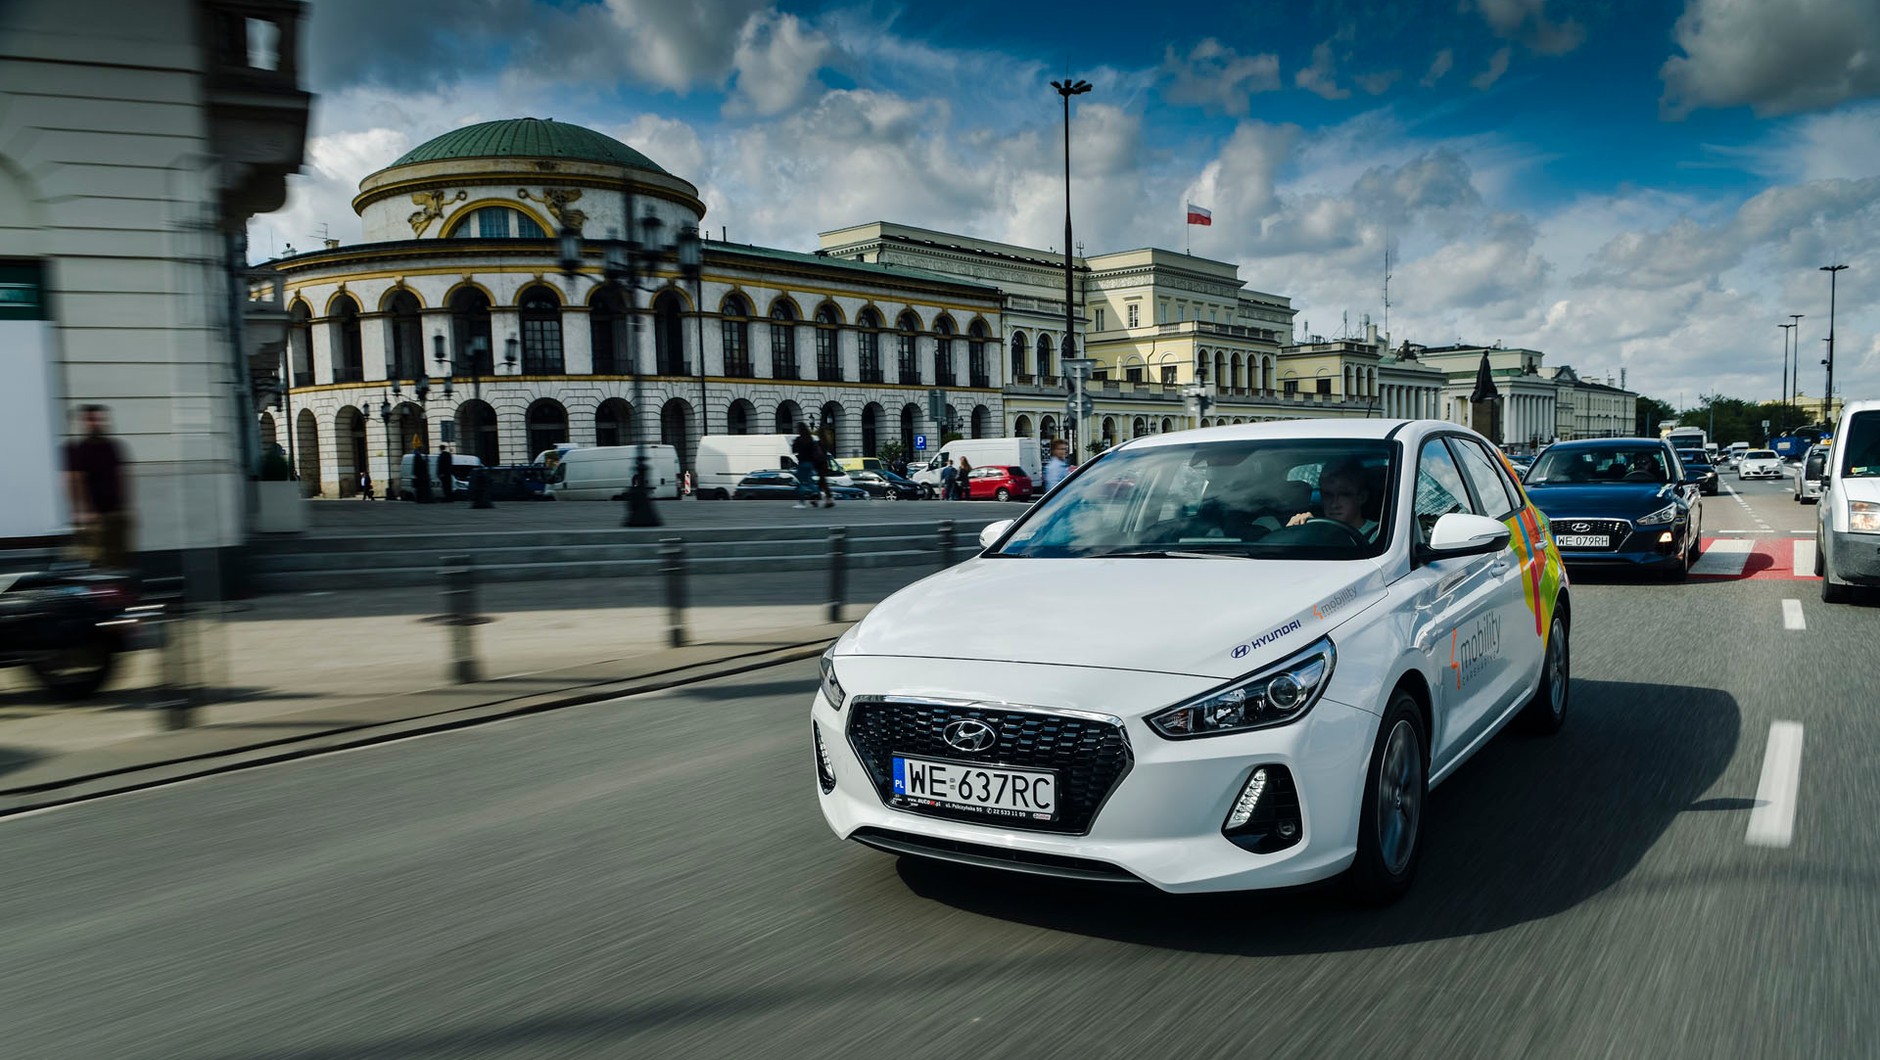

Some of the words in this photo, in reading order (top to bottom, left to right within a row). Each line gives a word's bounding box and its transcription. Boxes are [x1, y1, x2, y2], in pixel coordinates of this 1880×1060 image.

[917, 436, 924, 446] P
[1558, 536, 1573, 546] WE
[1576, 536, 1608, 546] 079RH
[1252, 619, 1302, 649] HYUNDAI
[894, 779, 904, 789] PL
[909, 762, 947, 798] WE
[958, 769, 1051, 810] 637RC
